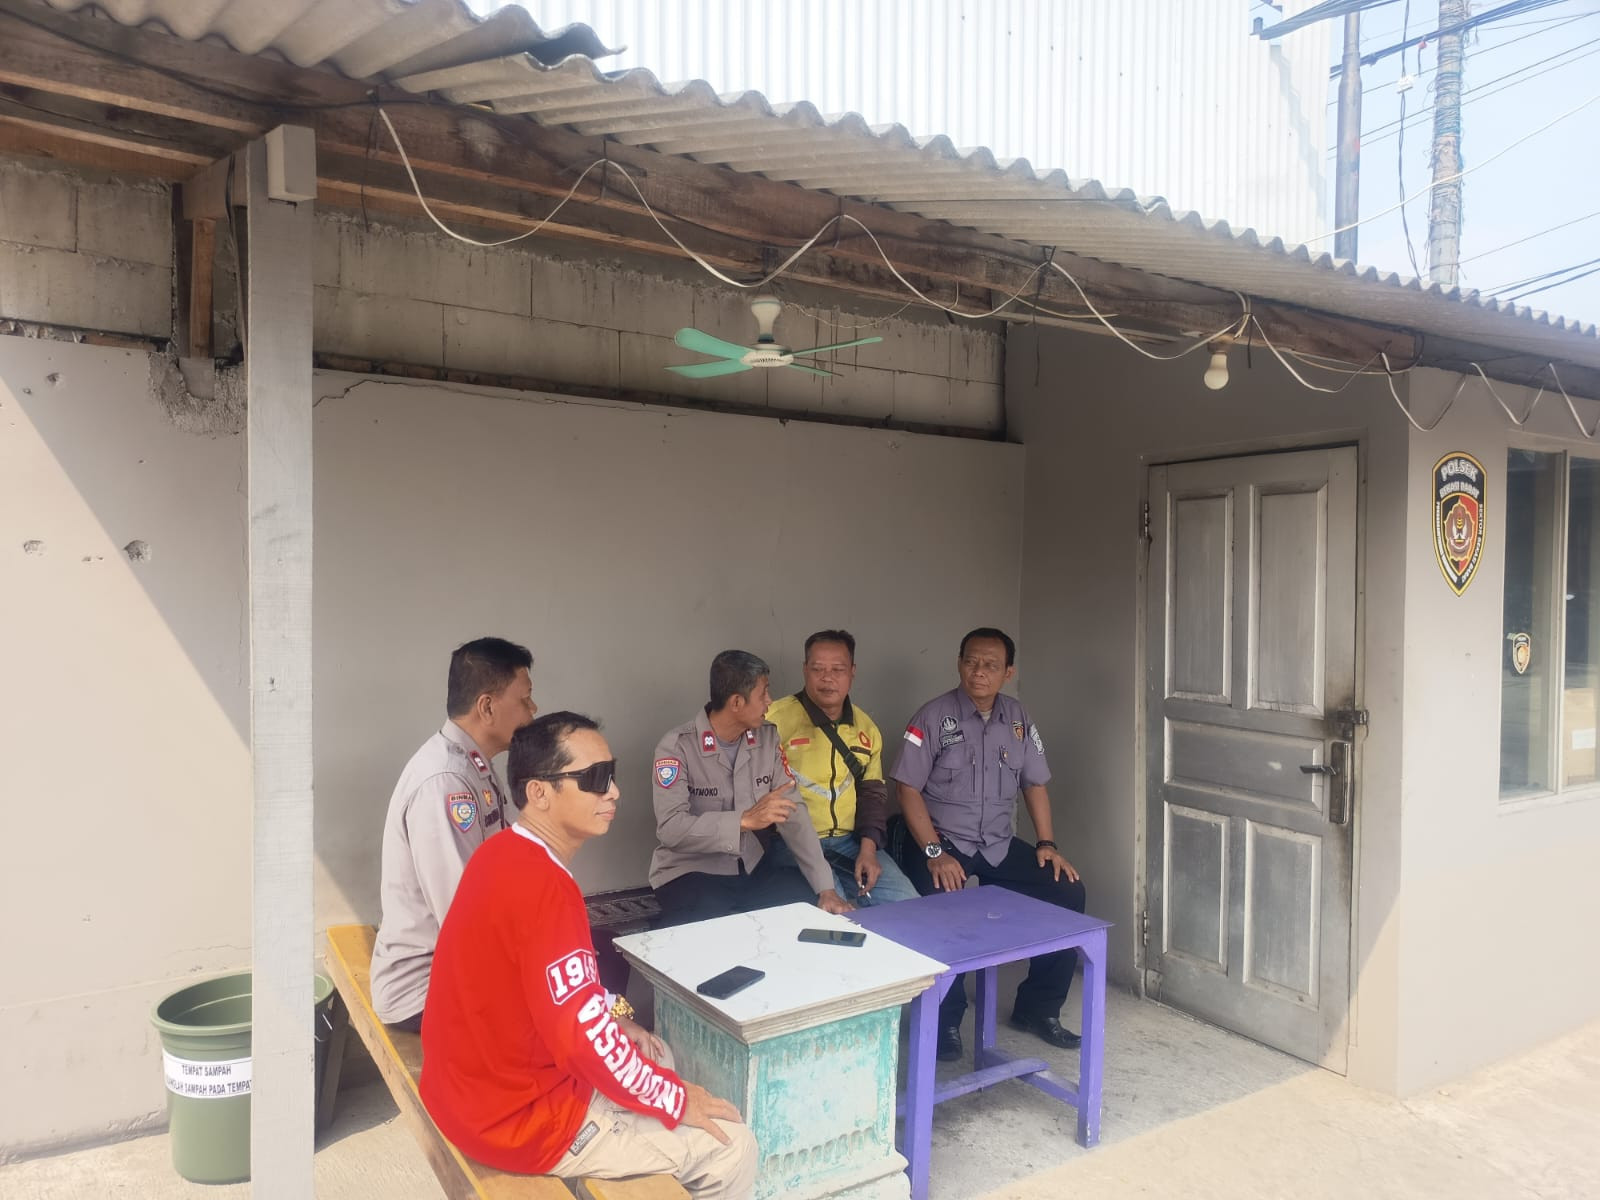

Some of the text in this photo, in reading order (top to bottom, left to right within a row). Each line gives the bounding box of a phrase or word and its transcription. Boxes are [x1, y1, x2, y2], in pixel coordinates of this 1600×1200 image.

[1440, 459, 1478, 483] POLSEK
[577, 993, 685, 1120] INDONESIA
[181, 1065, 232, 1077] TEMPAT SAMPAH
[184, 1082, 208, 1095] SAMPAH
[208, 1083, 226, 1095] PADA
